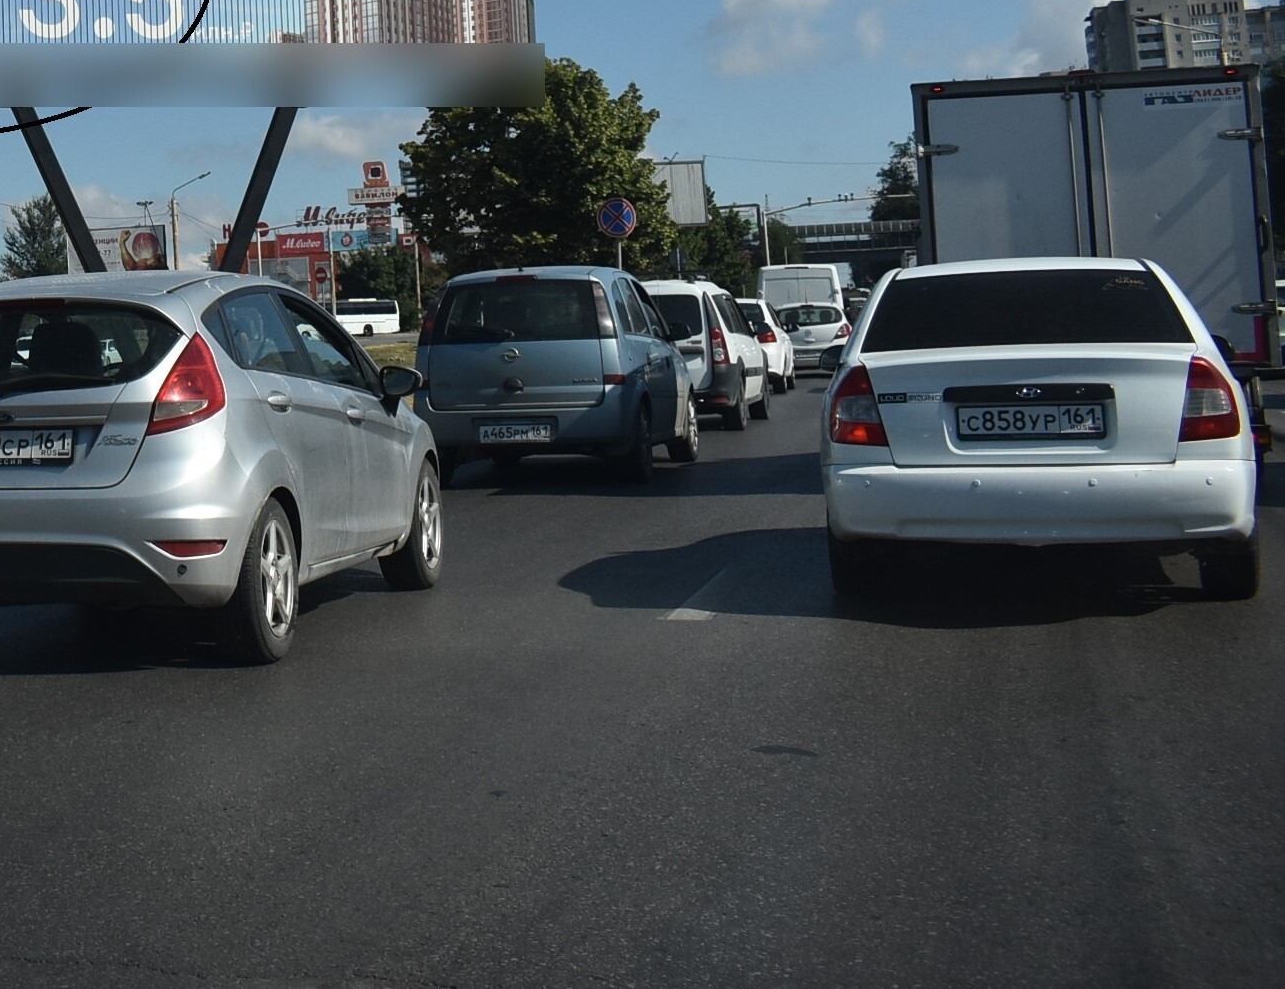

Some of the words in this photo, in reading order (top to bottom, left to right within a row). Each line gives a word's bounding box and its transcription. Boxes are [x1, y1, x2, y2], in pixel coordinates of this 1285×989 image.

[1192, 87, 1241, 97] ЛИДЕР
[296, 205, 368, 229] М.виде
[966, 410, 1056, 431] С858УР
[1061, 408, 1096, 424] 161
[35, 432, 66, 451] 161
[482, 426, 529, 440] А465РМ
[530, 425, 548, 436] 161
